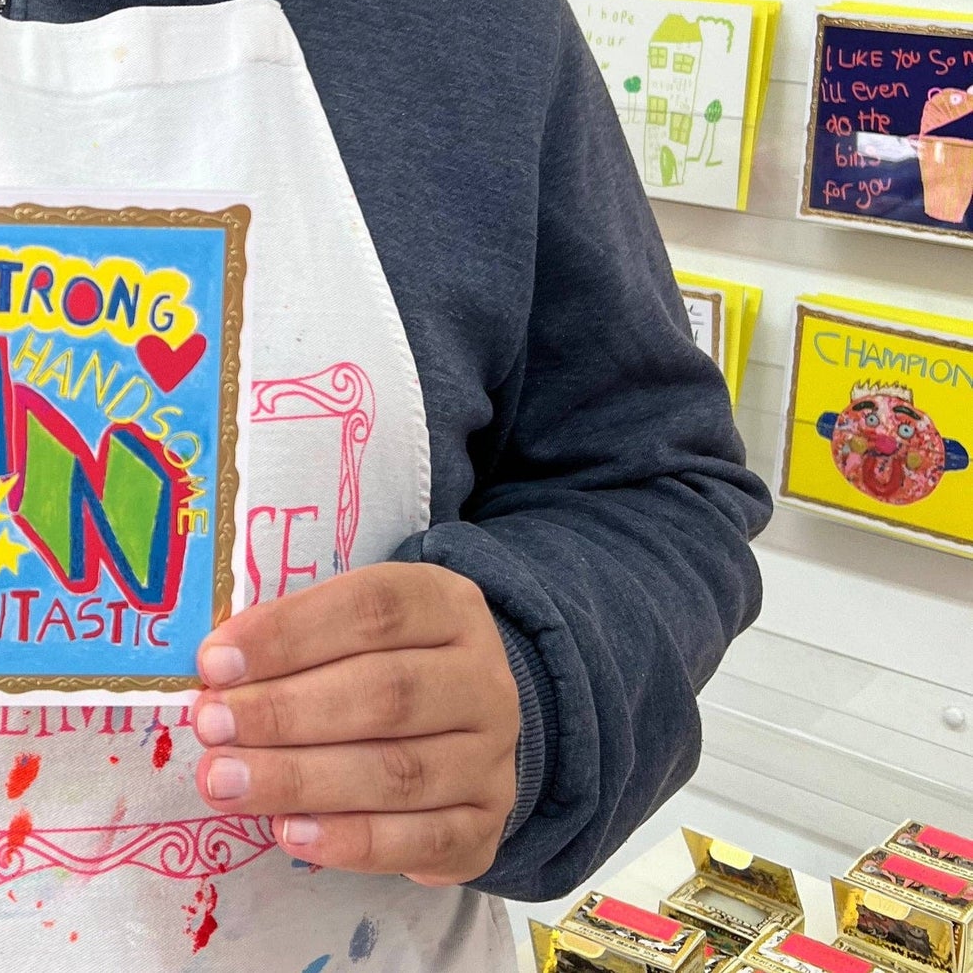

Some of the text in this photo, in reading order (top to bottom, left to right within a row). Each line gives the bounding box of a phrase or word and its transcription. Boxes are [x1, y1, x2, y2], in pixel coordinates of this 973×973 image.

[838, 48, 883, 69] LIKE
[851, 80, 910, 101] even
[857, 107, 891, 134] the
[822, 176, 893, 211] for you
[813, 330, 973, 390] CHAMPION
